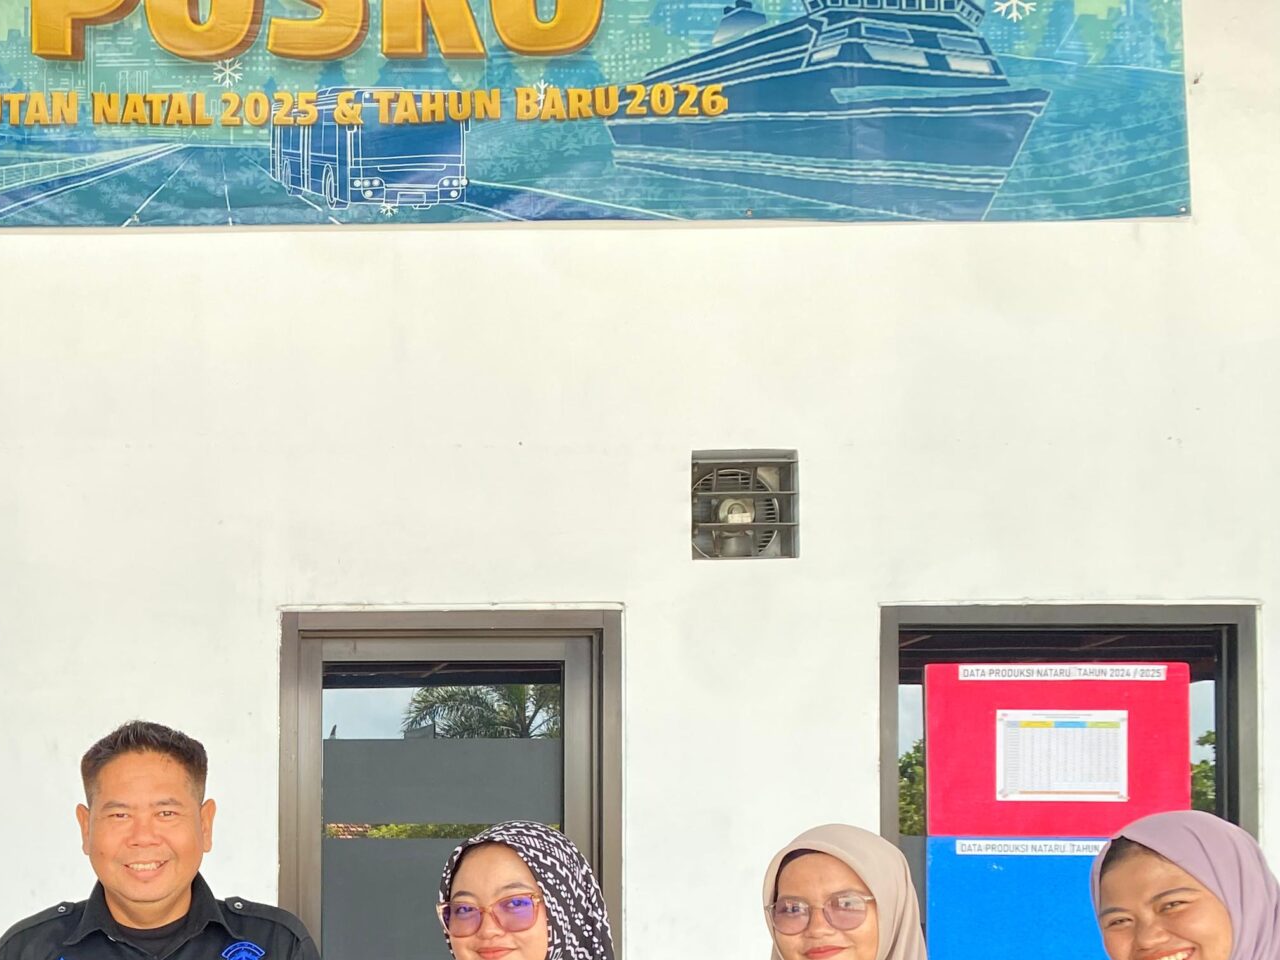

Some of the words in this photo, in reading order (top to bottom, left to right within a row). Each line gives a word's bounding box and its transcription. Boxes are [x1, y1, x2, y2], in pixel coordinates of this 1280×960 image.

[90, 91, 214, 126] NATAL
[219, 91, 320, 126] 2025
[332, 91, 365, 126] &
[373, 88, 501, 124] TAHUN
[515, 85, 620, 121] BARU
[623, 83, 729, 118] 2026
[962, 668, 987, 679] DATA
[988, 668, 1035, 679] PRODUKSI
[1036, 668, 1071, 678] NATARU
[1077, 667, 1108, 678] TAHUN
[1109, 667, 1131, 678] 2024
[960, 842, 983, 854] DATA
[985, 842, 1028, 854] PRODUKSI
[1030, 842, 1066, 854] NATARU
[1071, 842, 1100, 854] TAHUN
